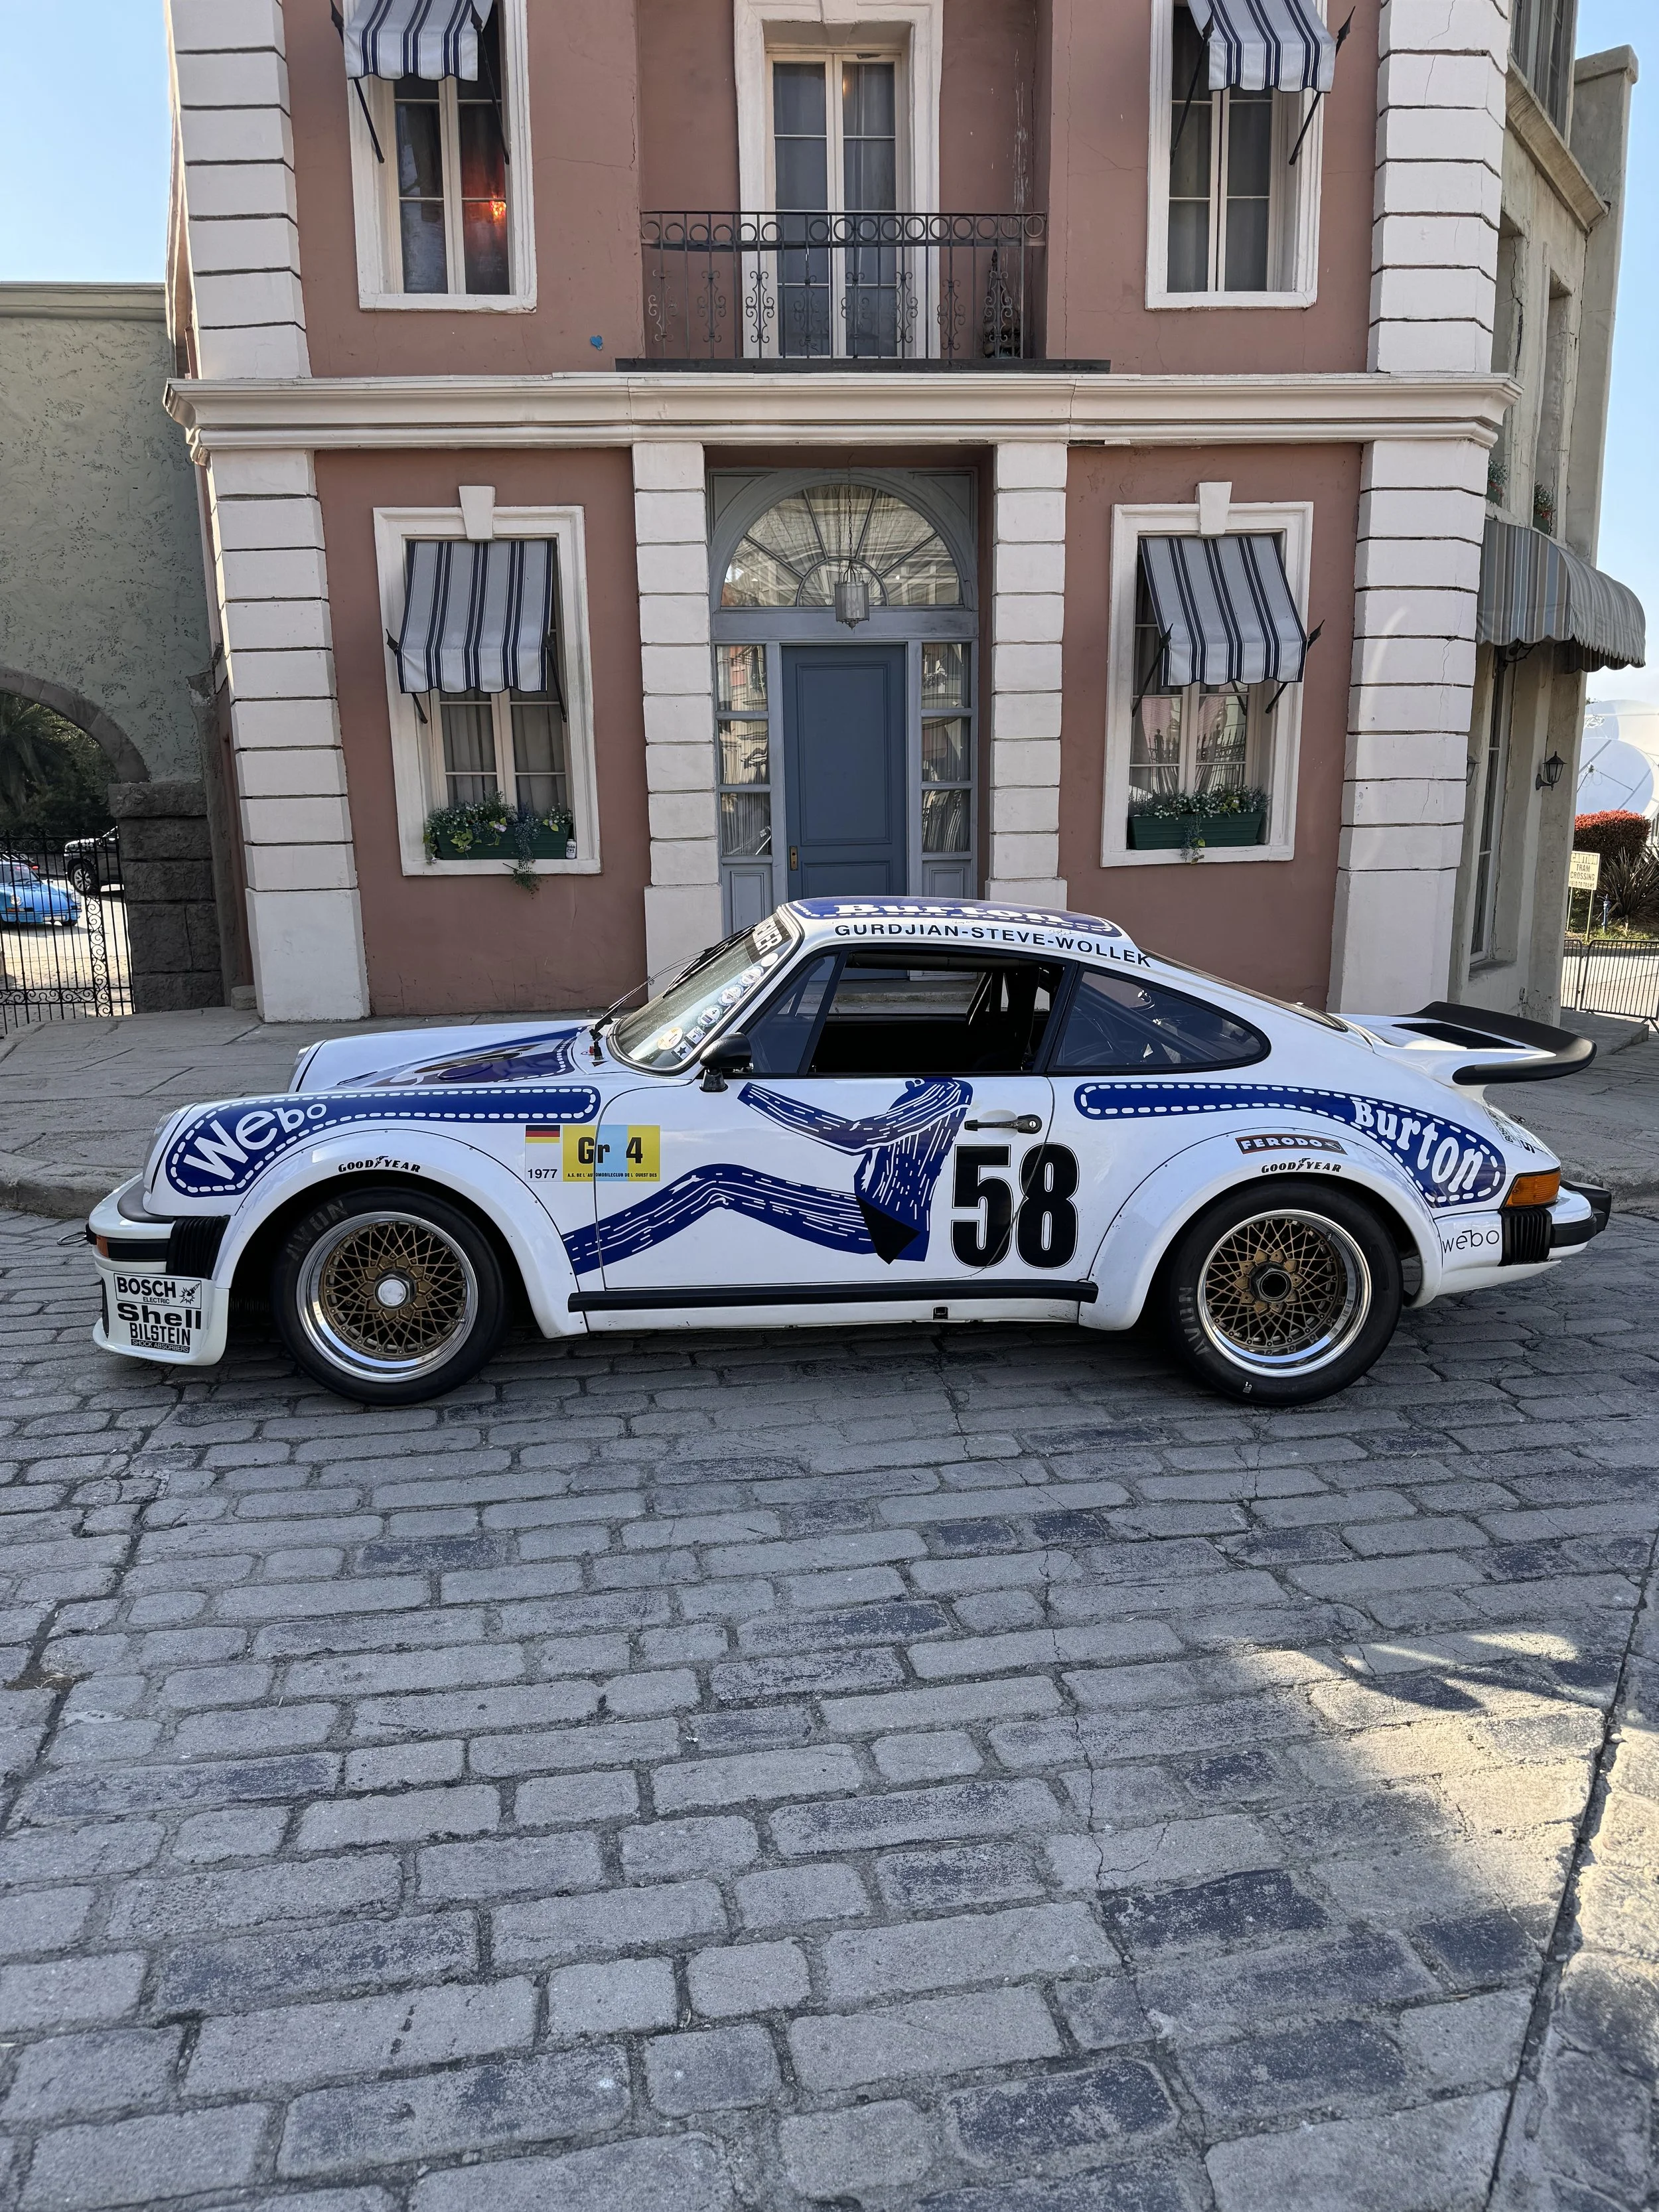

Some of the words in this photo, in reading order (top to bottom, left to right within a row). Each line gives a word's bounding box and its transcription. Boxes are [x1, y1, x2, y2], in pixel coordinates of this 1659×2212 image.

[1570, 871, 1595, 881] CROSSING
[1576, 863, 1591, 873] TRAM
[833, 904, 1073, 923] Burton
[834, 924, 1152, 968] GURDJIAN-STEVE-WOLLEK
[183, 1103, 327, 1180] Webo
[578, 1137, 610, 1164] Gr
[626, 1137, 643, 1164] 4
[1240, 1137, 1323, 1150] FERODO
[1352, 1100, 1483, 1193] Burton
[527, 1168, 558, 1179] 1977
[950, 1142, 1080, 1270] 58
[286, 1200, 348, 1261] AVON
[1442, 1230, 1500, 1254] webo
[117, 1276, 177, 1298] BOSCH
[143, 1296, 170, 1305] ELECTRIC
[117, 1302, 202, 1330] Shell
[129, 1322, 191, 1346] BILSTEIN
[132, 1339, 153, 1348] SHOCK
[153, 1341, 190, 1353] ABSORBERS
